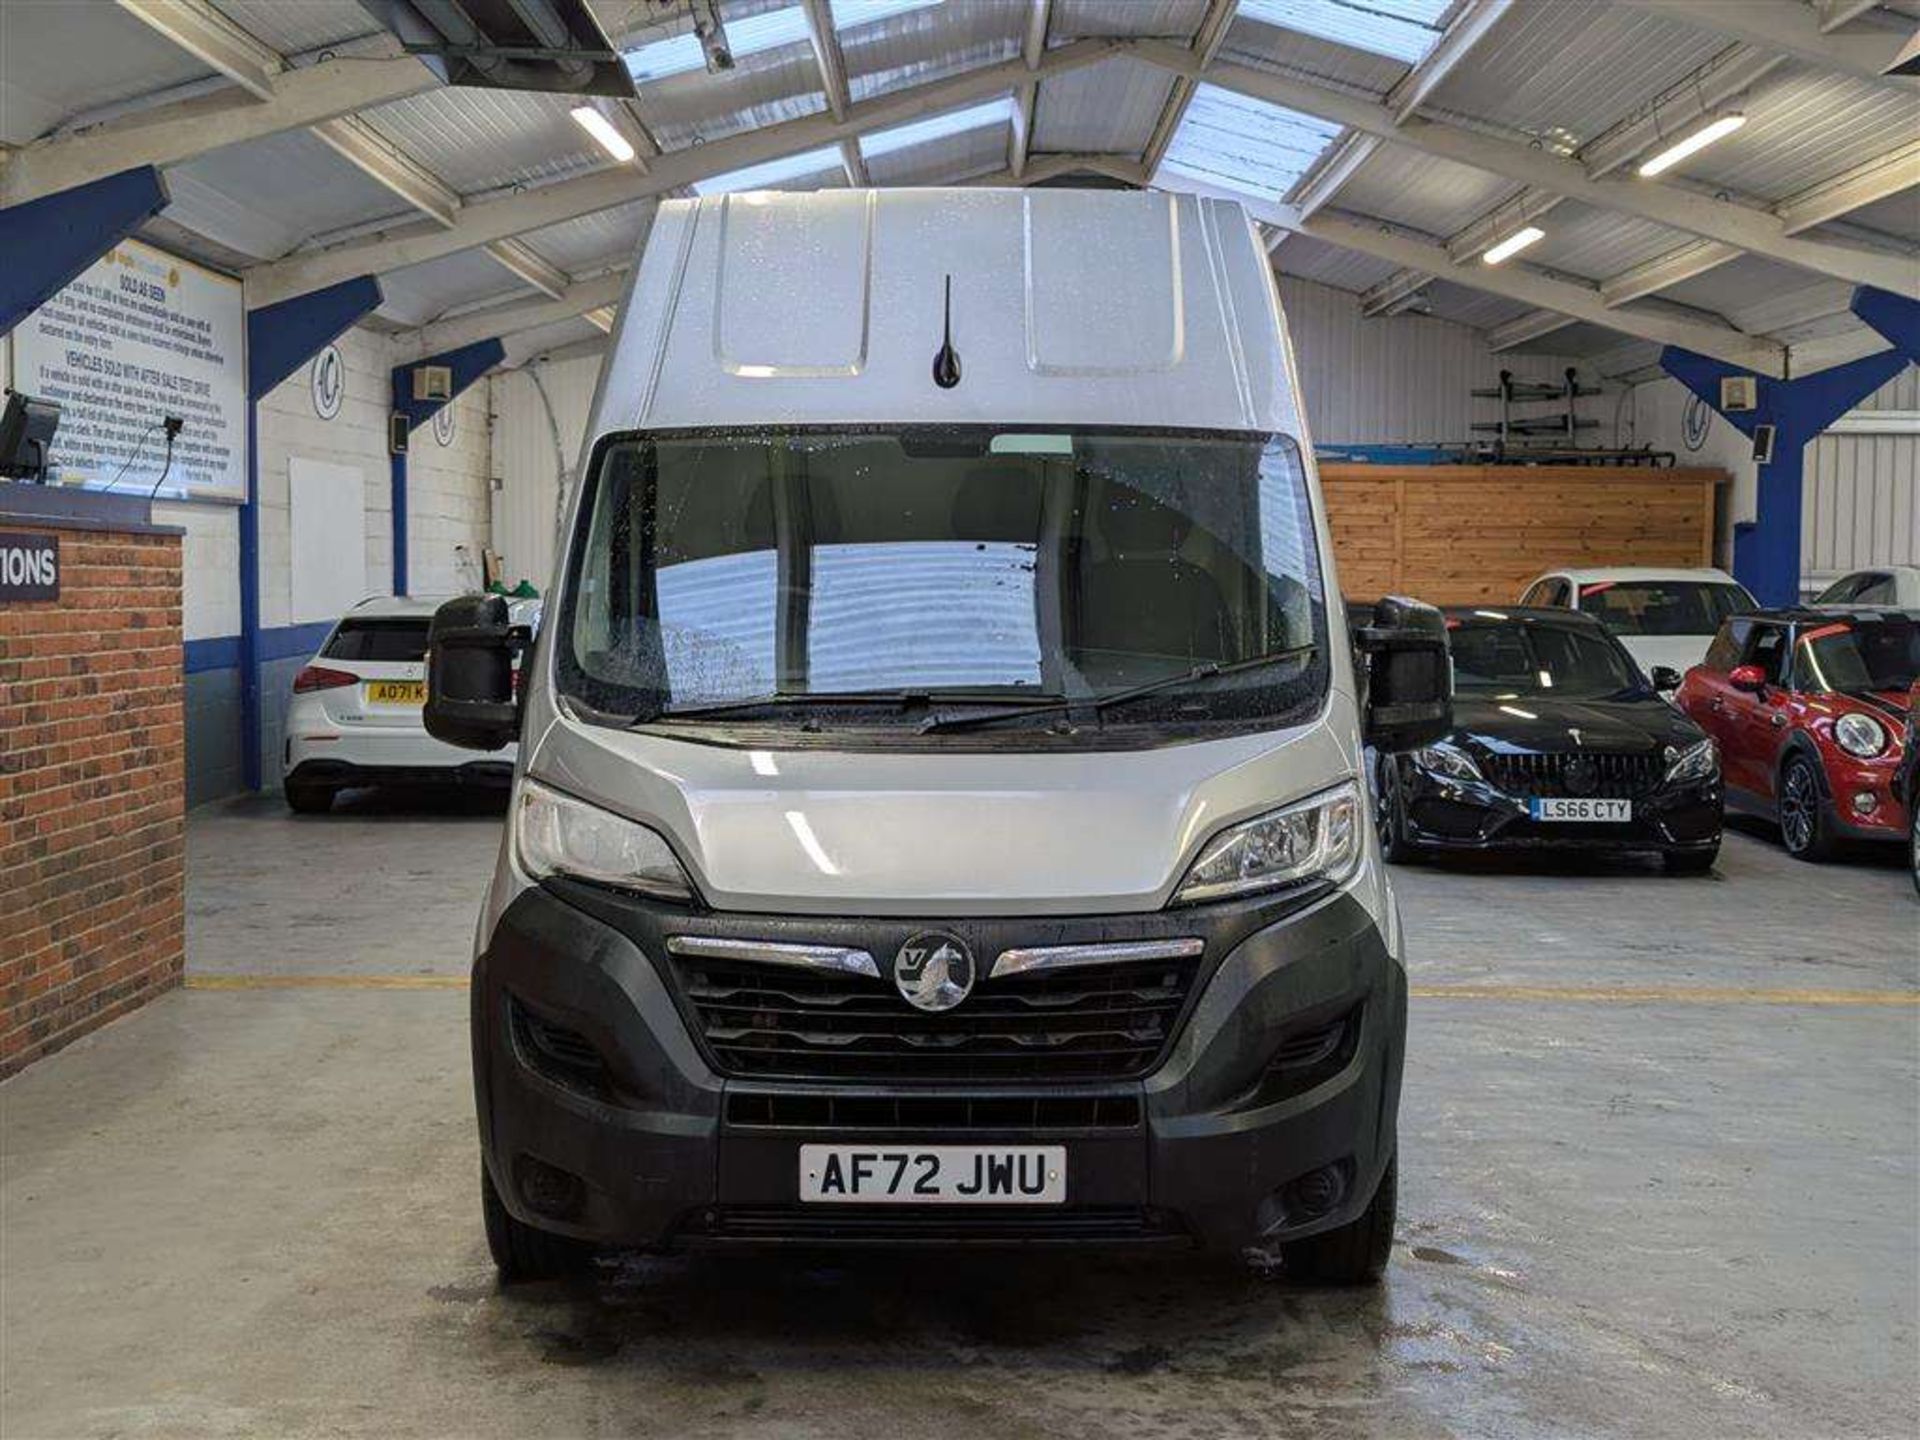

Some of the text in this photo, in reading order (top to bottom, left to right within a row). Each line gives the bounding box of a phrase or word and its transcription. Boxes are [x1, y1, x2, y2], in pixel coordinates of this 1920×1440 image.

[65, 351, 102, 373] VEHICLES
[0, 547, 56, 586] IONS
[1543, 801, 1626, 818] LS66 CTY
[820, 1152, 1046, 1195] AF72 JWU
